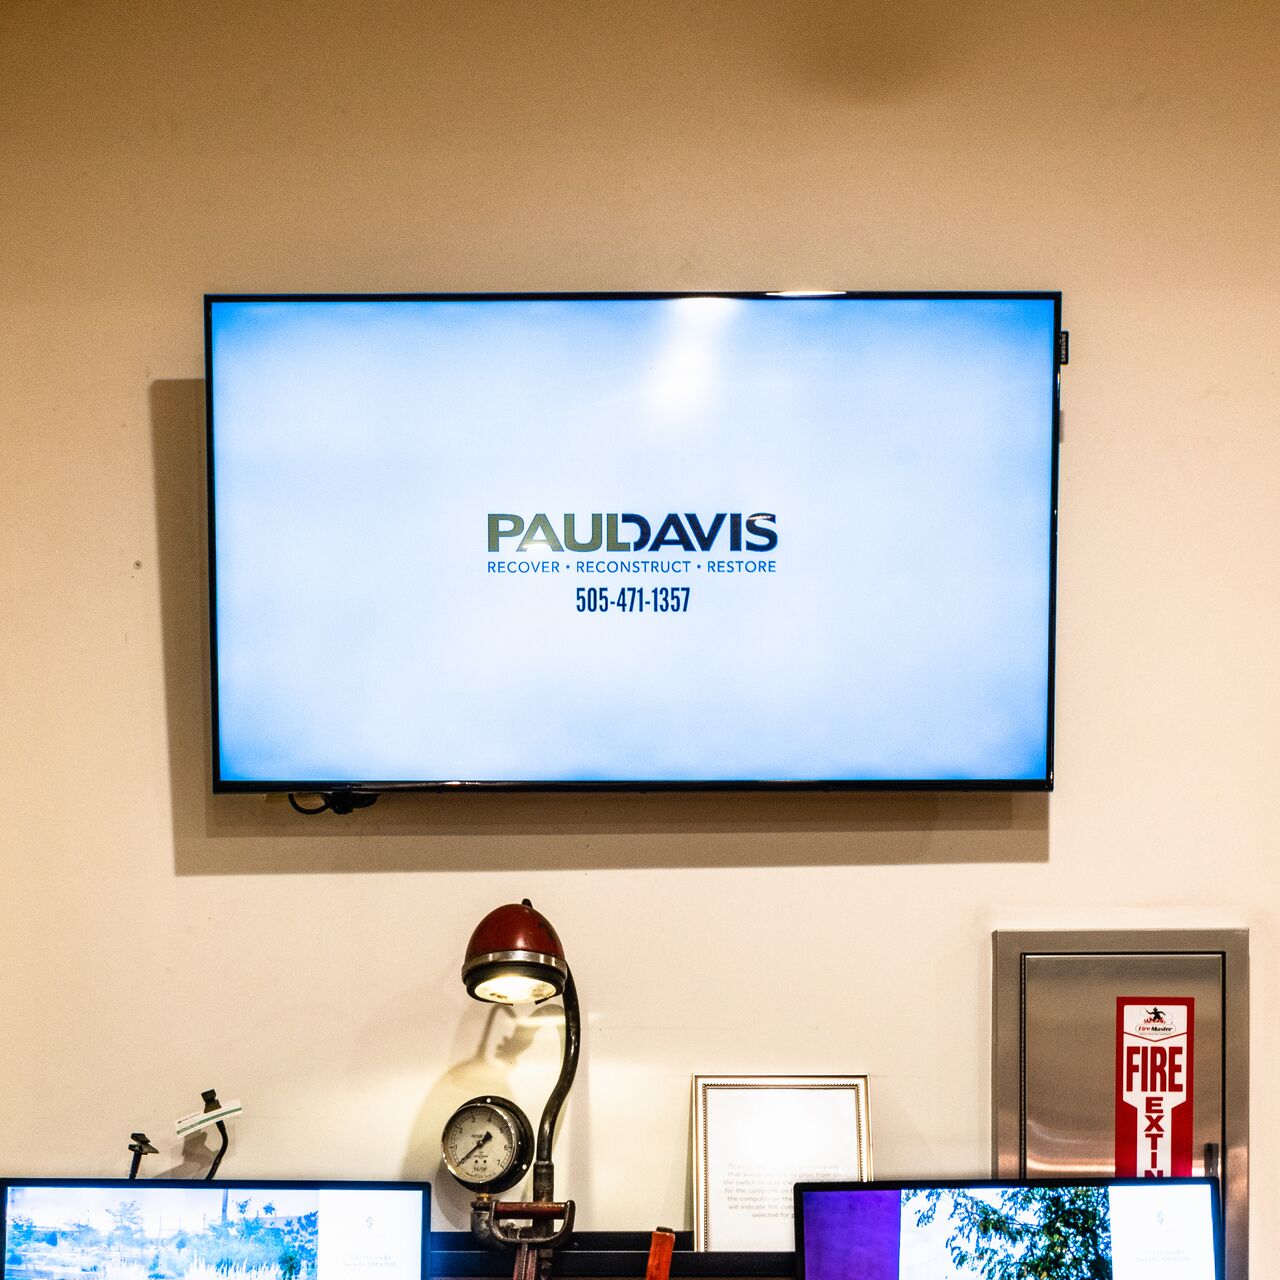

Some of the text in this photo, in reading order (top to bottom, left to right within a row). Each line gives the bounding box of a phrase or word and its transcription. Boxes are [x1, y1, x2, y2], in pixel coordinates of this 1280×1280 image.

[487, 560, 777, 573] RECOVER RECONSTRUCT RESTORE
[576, 587, 691, 612] 505-471-1357
[1126, 1046, 1183, 1092] FIRE
